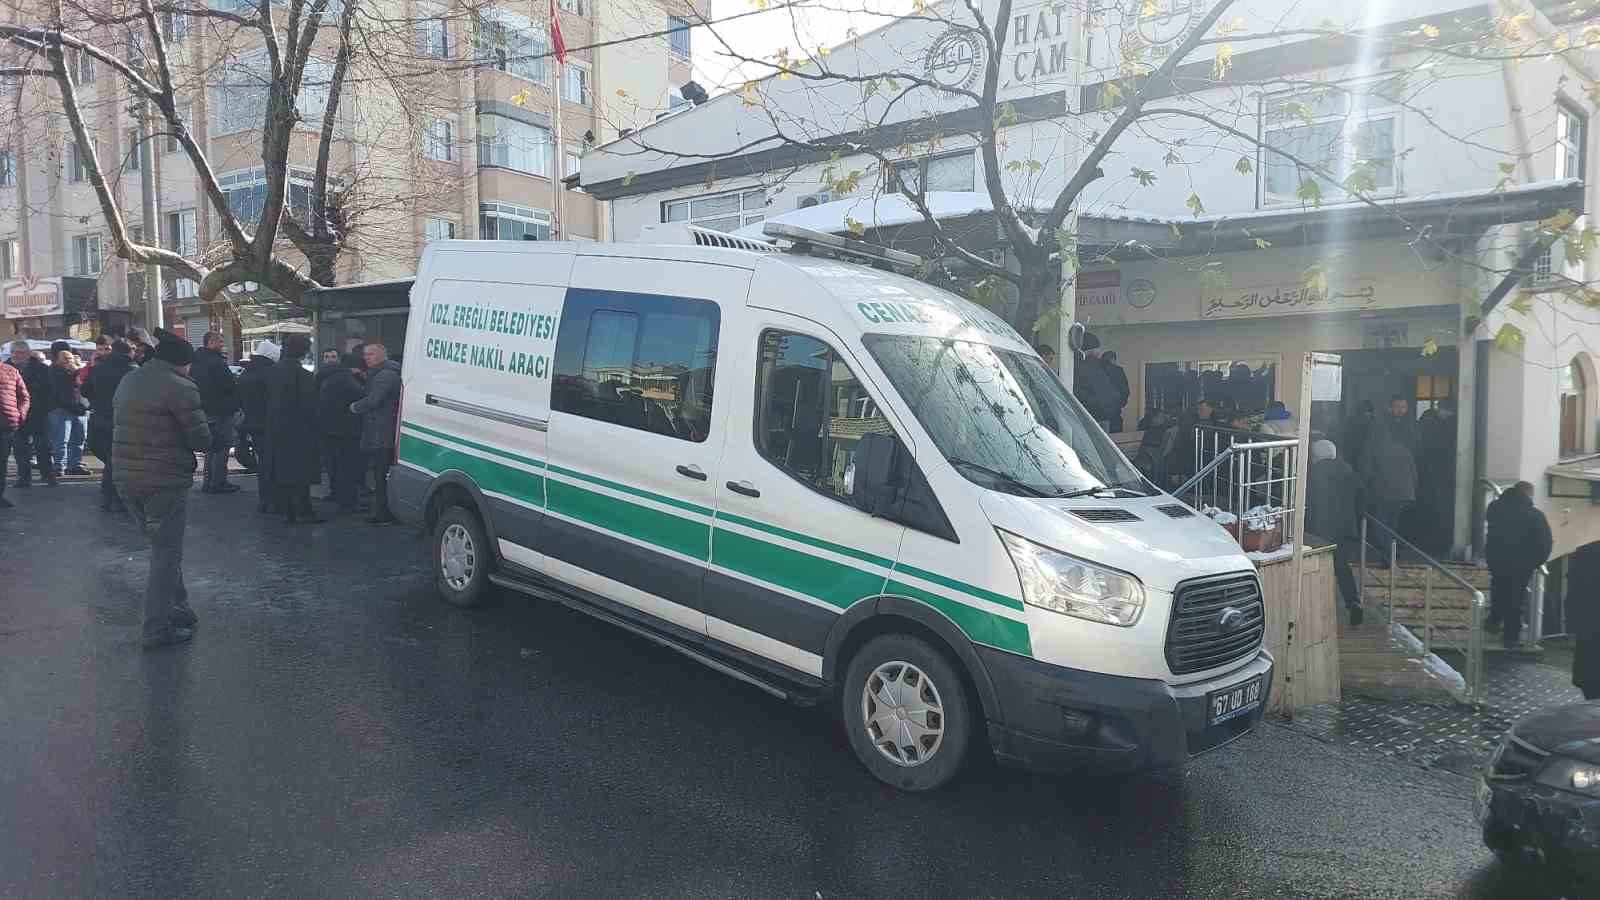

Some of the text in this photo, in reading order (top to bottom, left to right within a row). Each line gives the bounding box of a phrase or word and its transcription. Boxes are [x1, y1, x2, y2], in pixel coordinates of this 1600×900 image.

[430, 302, 559, 341] KDZ. EREĞLİ BELEDİYESİ
[426, 337, 550, 380] CENAZE NAKİL ARACI
[1216, 694, 1228, 716] 67
